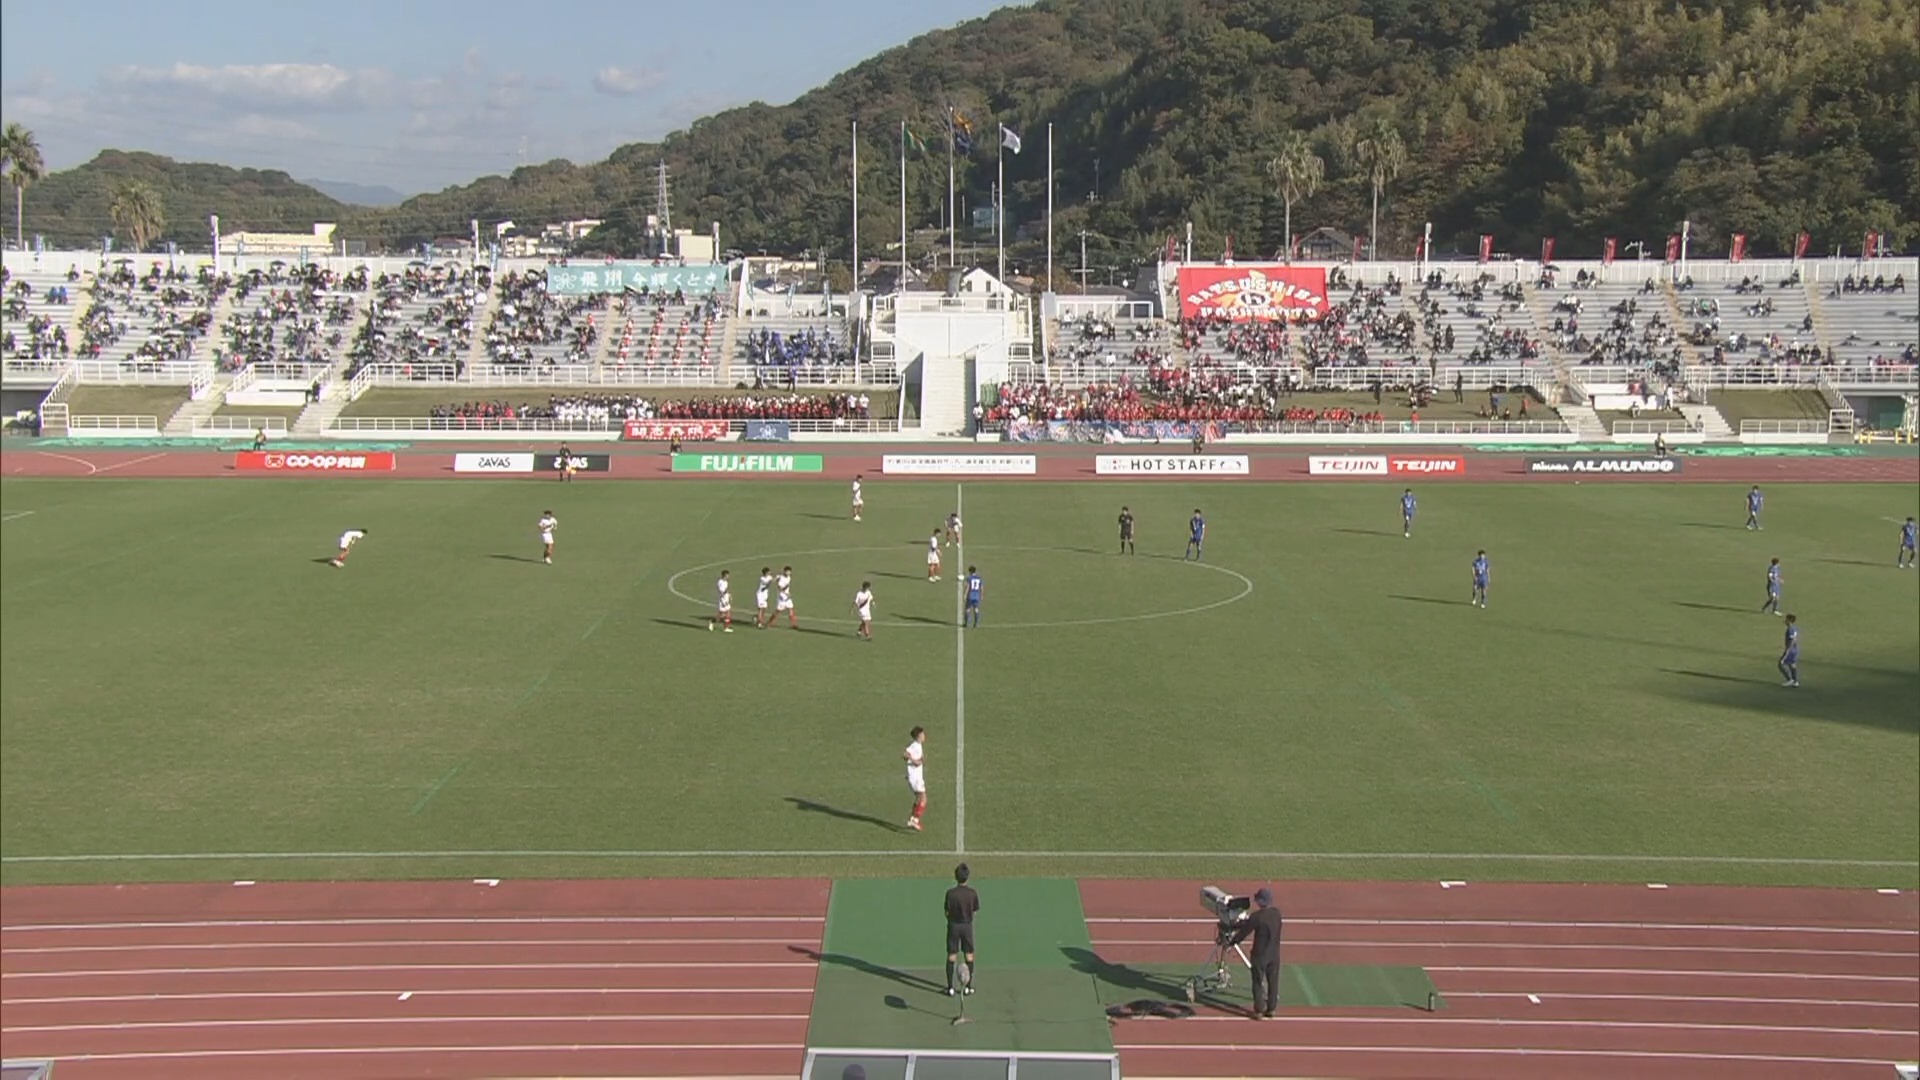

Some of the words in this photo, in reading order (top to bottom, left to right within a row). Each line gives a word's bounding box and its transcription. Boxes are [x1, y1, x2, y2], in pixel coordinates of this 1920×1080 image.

[701, 455, 794, 471] FUJIFILM
[1131, 459, 1163, 470] HOT
[1167, 459, 1217, 470] STAFF
[1317, 461, 1379, 472] TEIJIN
[1392, 460, 1457, 472] TEIJIN
[1573, 460, 1674, 472] ALMUNDO
